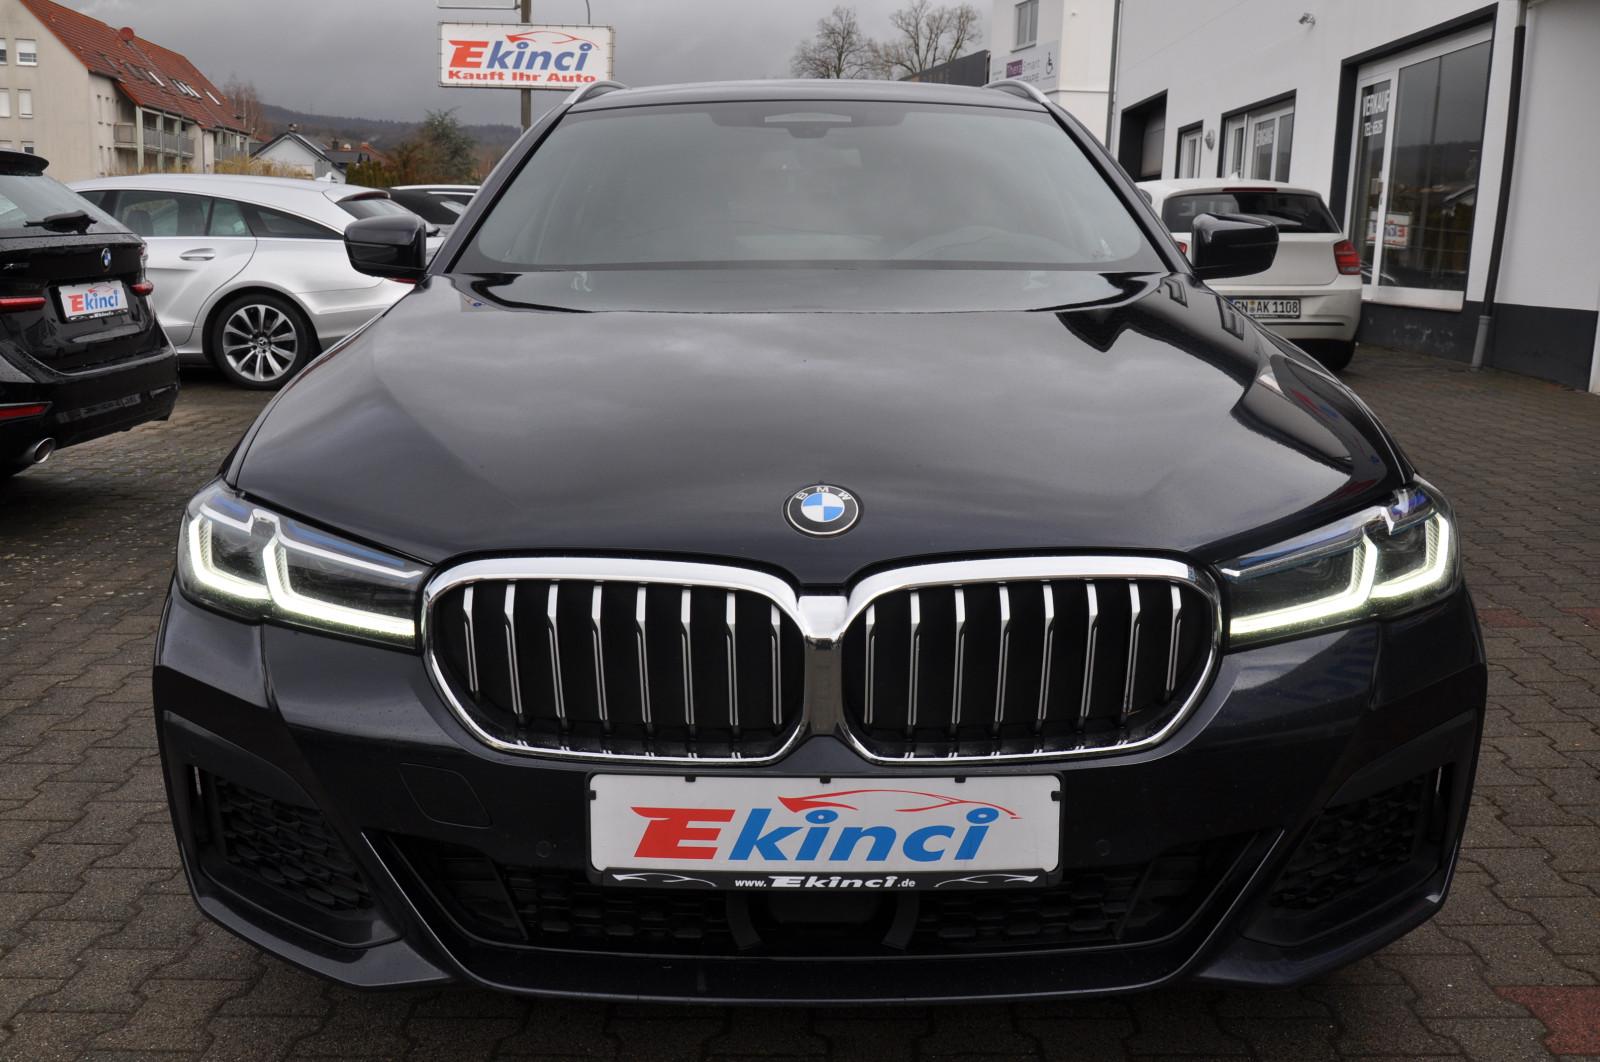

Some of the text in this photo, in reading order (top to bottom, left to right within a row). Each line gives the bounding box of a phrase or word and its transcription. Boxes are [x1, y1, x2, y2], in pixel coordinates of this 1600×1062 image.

[448, 40, 593, 72] Ekinci
[448, 70, 596, 84] Kauft Ihr Auto
[68, 289, 119, 312] Ekinci
[1256, 301, 1270, 313] AK
[1272, 301, 1298, 314] 1108
[795, 486, 852, 501] BMW
[630, 806, 1000, 862] Ekinci
[734, 875, 916, 888] www.Ekinci.de
